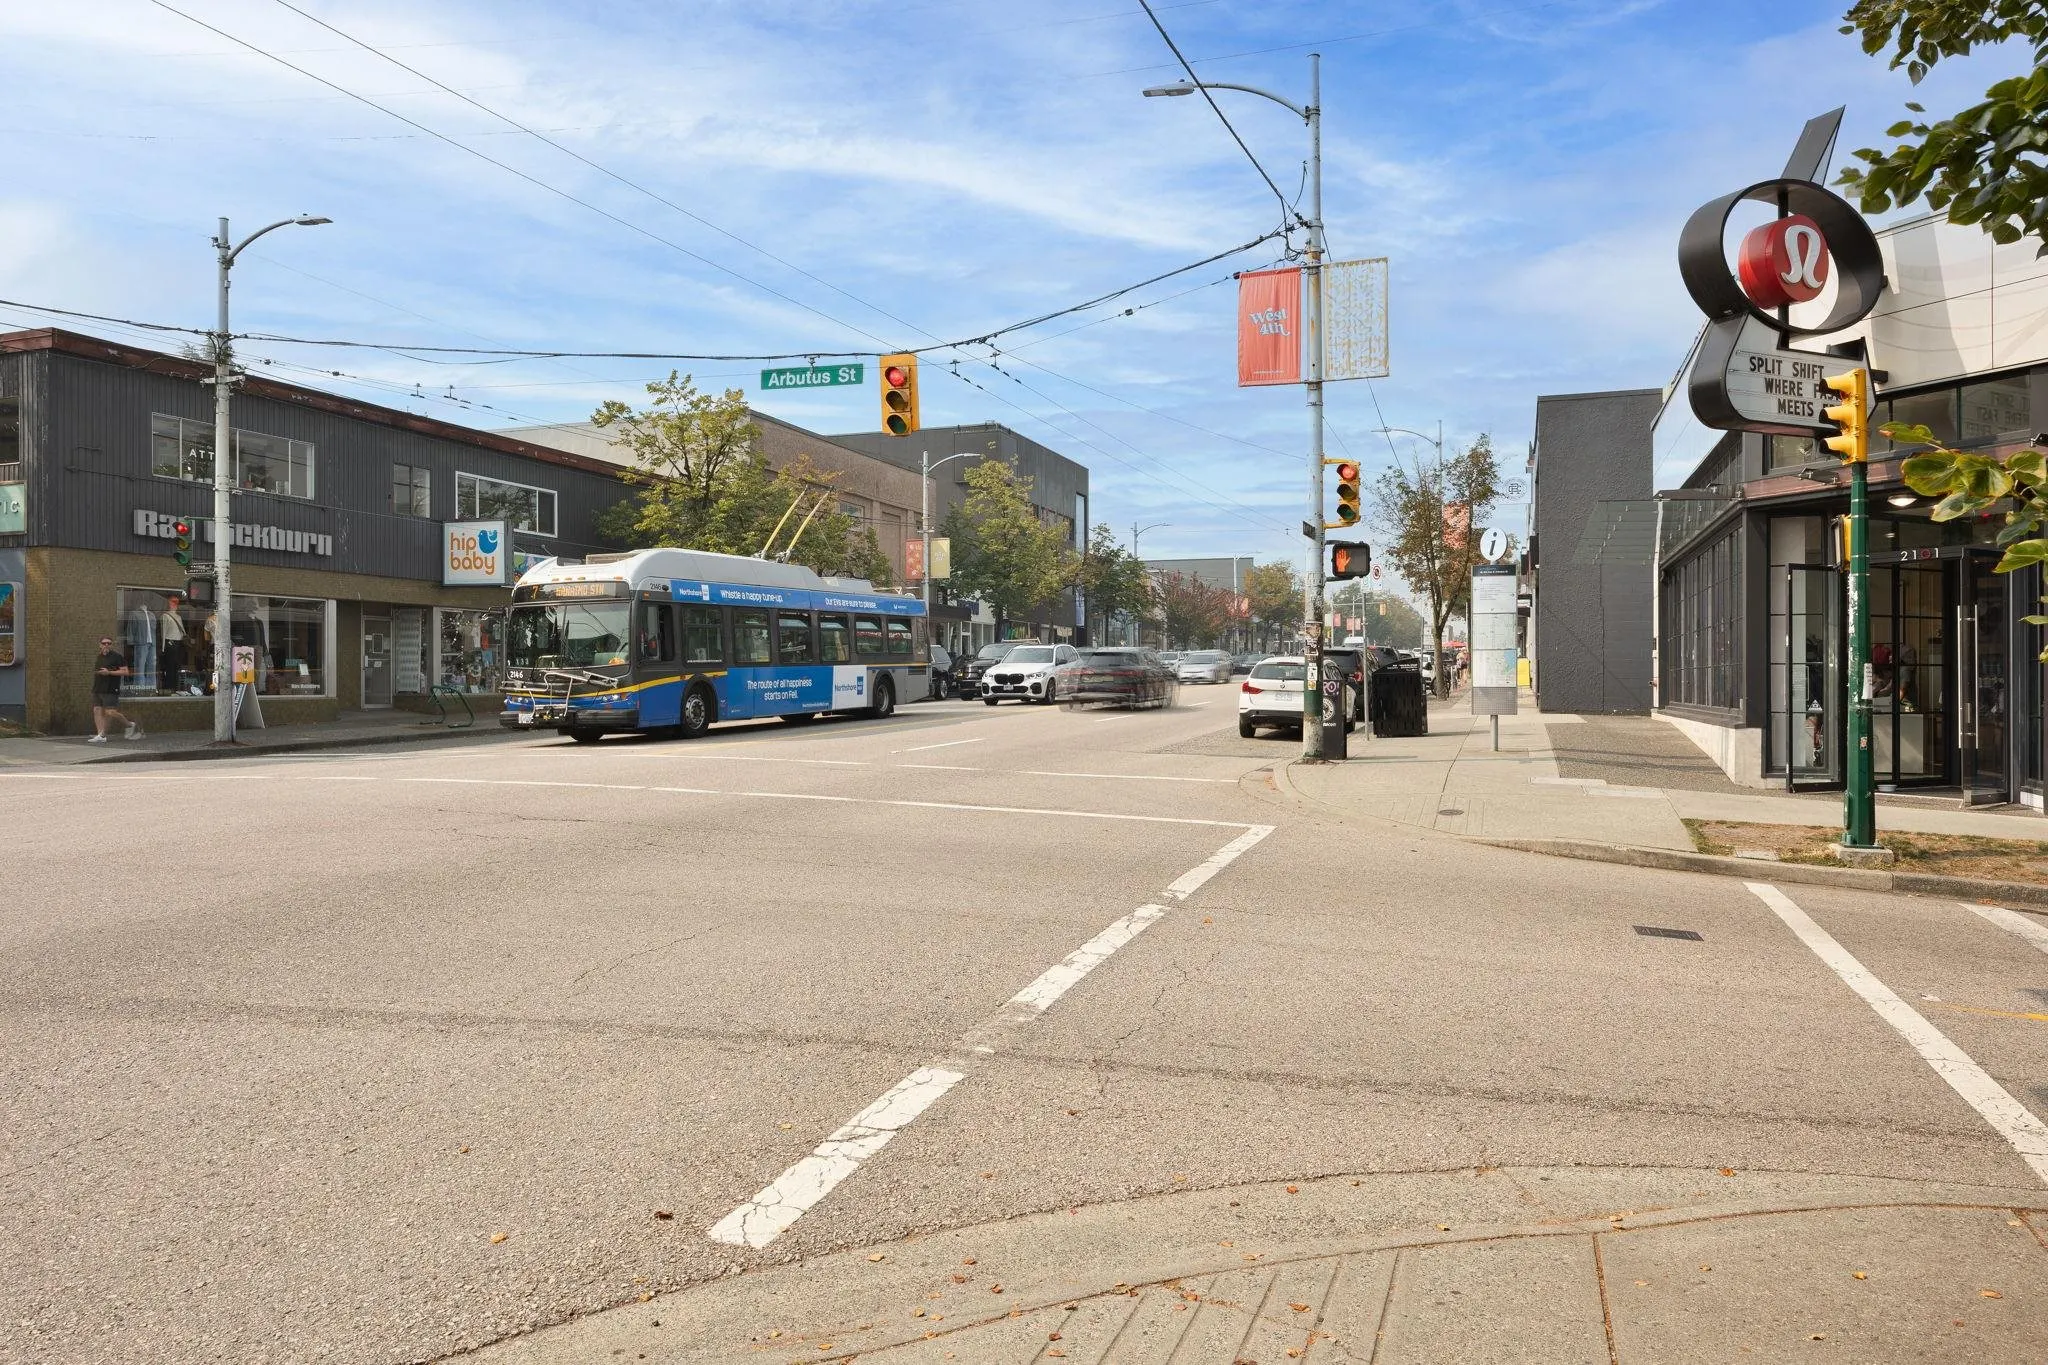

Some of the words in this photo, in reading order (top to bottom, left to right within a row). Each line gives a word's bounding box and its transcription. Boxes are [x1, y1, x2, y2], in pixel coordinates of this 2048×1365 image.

[1248, 307, 1287, 325] West
[1749, 355, 1783, 376] SPLIT
[1792, 361, 1825, 380] SHIFT
[768, 371, 831, 387] Arbutus
[838, 367, 856, 383] St
[1764, 377, 1803, 397] WHERE
[1777, 398, 1814, 417] MEETS
[189, 448, 215, 460] ATT
[0, 500, 19, 514] IC
[133, 509, 196, 541] Ra
[450, 532, 477, 556] hip
[450, 551, 495, 576] baby
[531, 584, 539, 600] 7
[720, 589, 741, 600] Whistle
[746, 592, 762, 603] happy
[747, 680, 758, 690] The
[758, 679, 773, 689] route
[773, 679, 780, 688] of
[787, 678, 812, 689] happiness
[764, 691, 782, 700] starts
[782, 690, 789, 700] on
